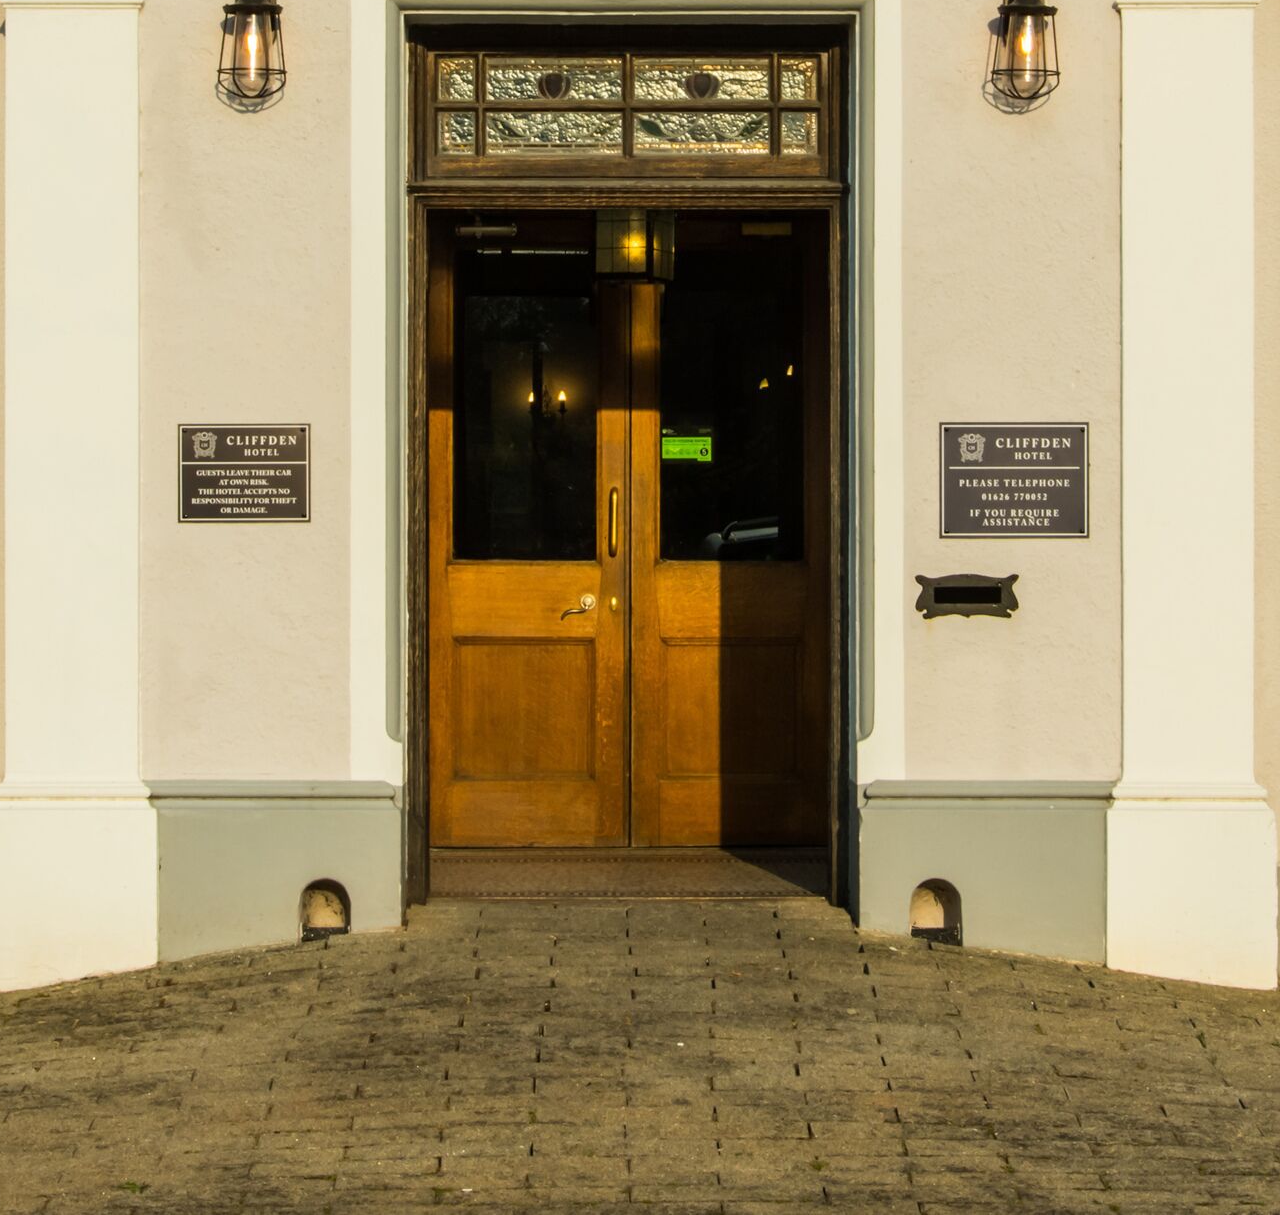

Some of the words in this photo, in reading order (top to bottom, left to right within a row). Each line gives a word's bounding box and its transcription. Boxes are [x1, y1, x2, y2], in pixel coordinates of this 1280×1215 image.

[226, 435, 297, 445] CLIFFDEN
[995, 438, 1071, 448] CLIFFDEN
[1014, 452, 1053, 460] HOTEL
[959, 479, 1000, 487] PLEASE
[1003, 479, 1070, 487] TELEPHONE
[969, 509, 981, 517] IF
[984, 509, 1006, 517] YOU
[1010, 509, 1060, 519] REQUIRE
[982, 518, 1050, 526] ASSISTANCE
